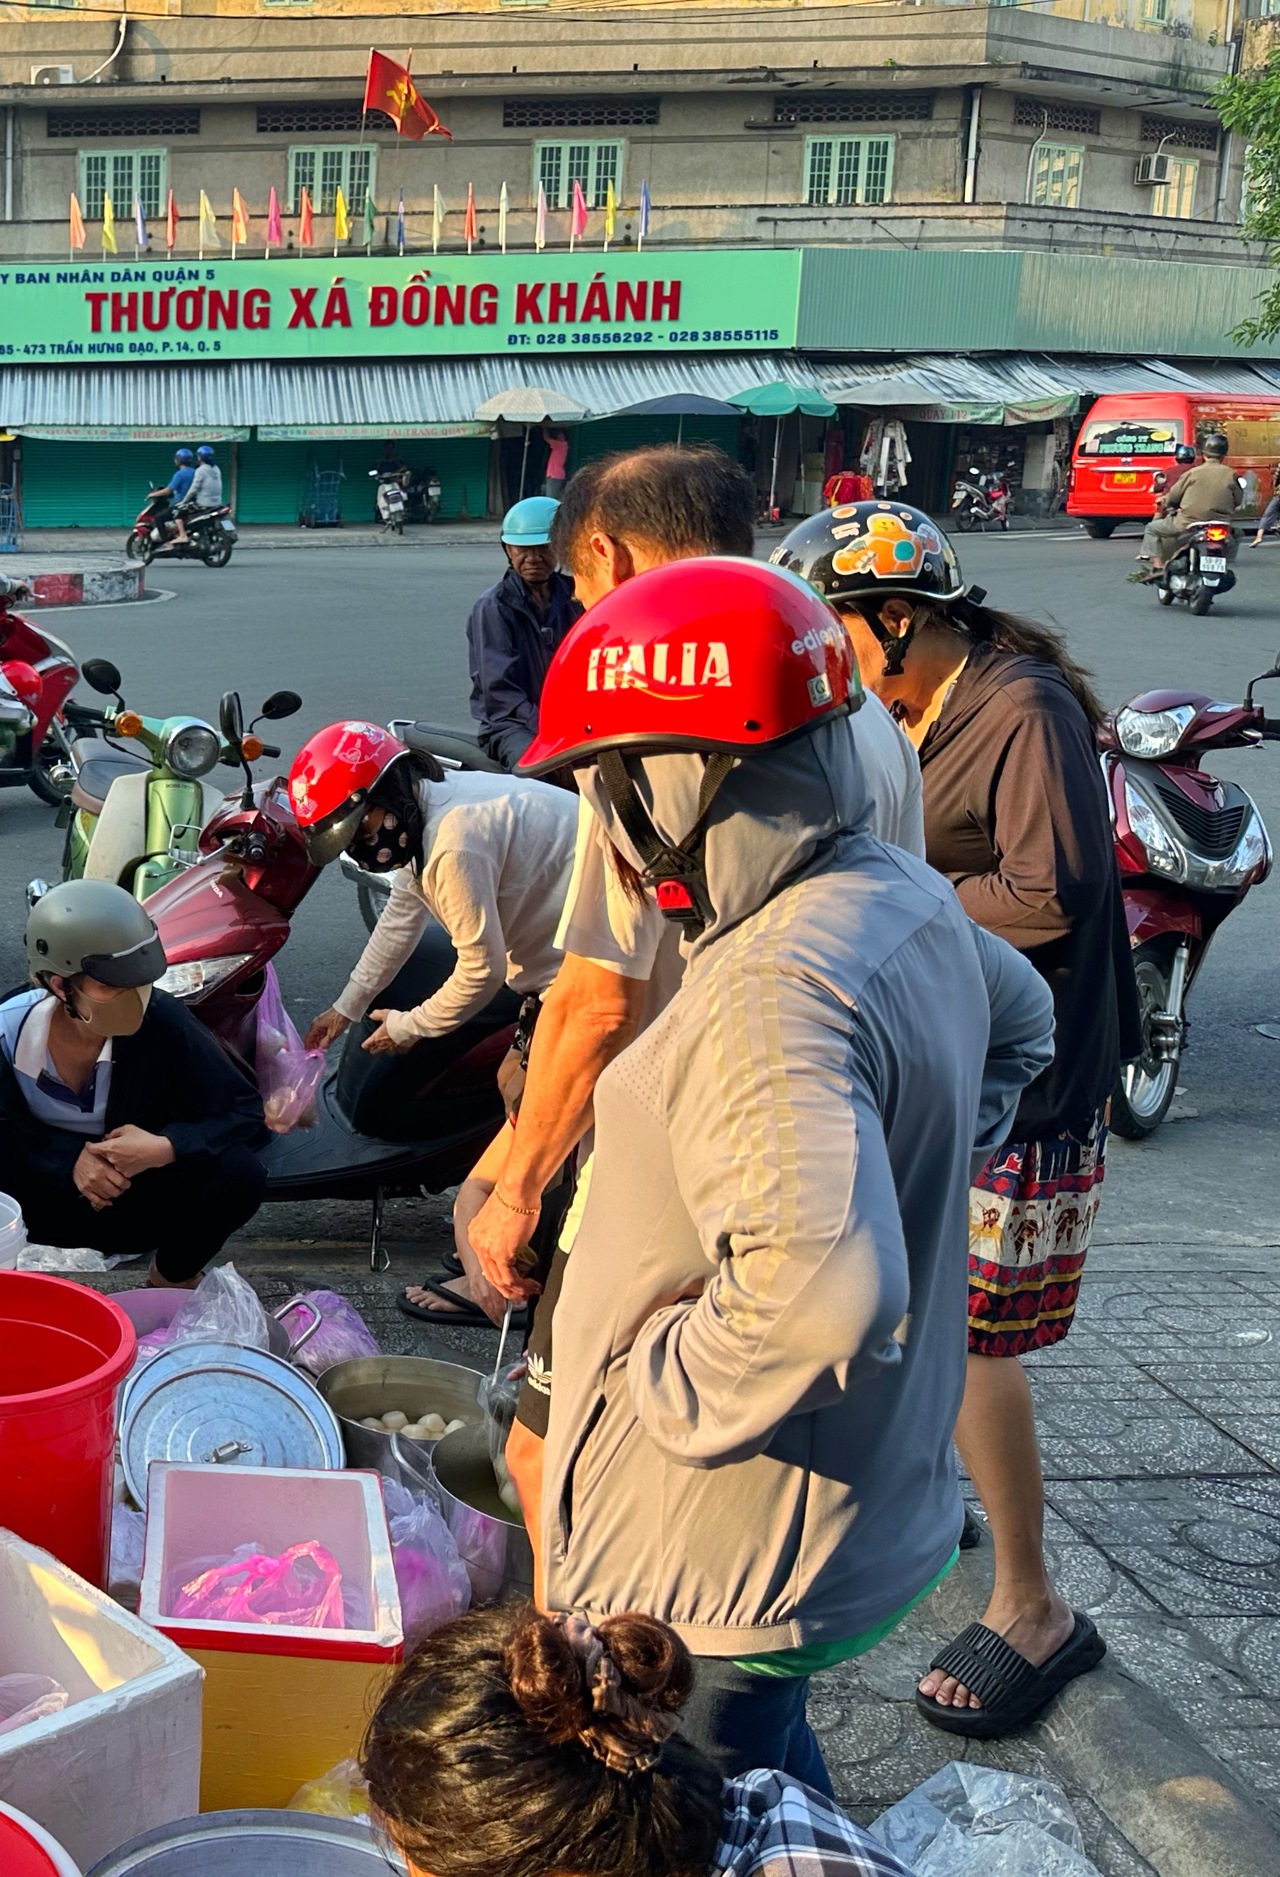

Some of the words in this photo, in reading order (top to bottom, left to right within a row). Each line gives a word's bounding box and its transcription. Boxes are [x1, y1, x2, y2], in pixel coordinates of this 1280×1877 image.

[15, 272, 50, 285] BAN
[56, 269, 105, 284] NHÂN
[110, 268, 146, 283] DÂN
[152, 267, 195, 285] QUẬN
[205, 269, 216, 281] 5
[85, 285, 271, 333] THƯƠNG
[287, 276, 353, 329] XÁ
[367, 269, 499, 328] ĐỒNG
[515, 272, 682, 324] KHÁNH
[507, 334, 530, 345] ĐT:
[536, 333, 566, 345] 028
[669, 331, 699, 343] 028
[702, 330, 779, 342] 38555115
[23, 344, 46, 355] 473
[50, 340, 83, 355] TRẦN
[88, 341, 124, 354] HƯNG
[129, 342, 158, 356] ĐẠO,
[213, 340, 221, 351] 5
[586, 642, 732, 692] ITALIA
